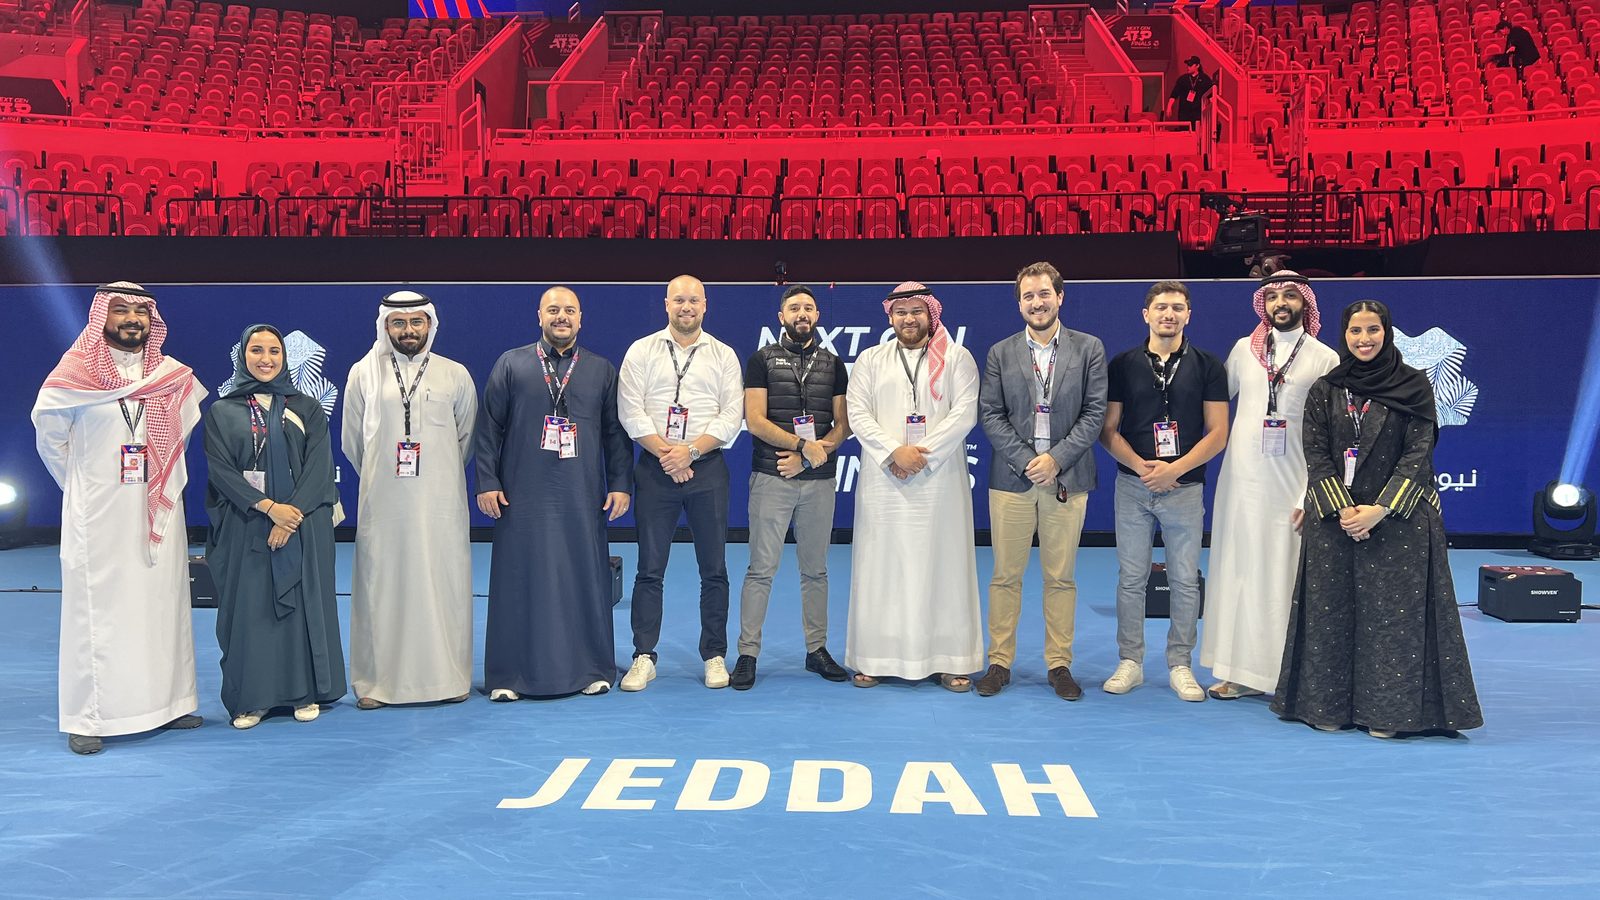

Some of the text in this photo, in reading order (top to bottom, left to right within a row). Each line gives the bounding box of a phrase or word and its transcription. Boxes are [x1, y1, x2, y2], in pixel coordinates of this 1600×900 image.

[549, 38, 580, 48] ATP
[1120, 30, 1152, 41] ATP
[758, 326, 870, 356] NXT
[1434, 469, 1477, 491] نيو
[496, 758, 1099, 818] JEDDAH
